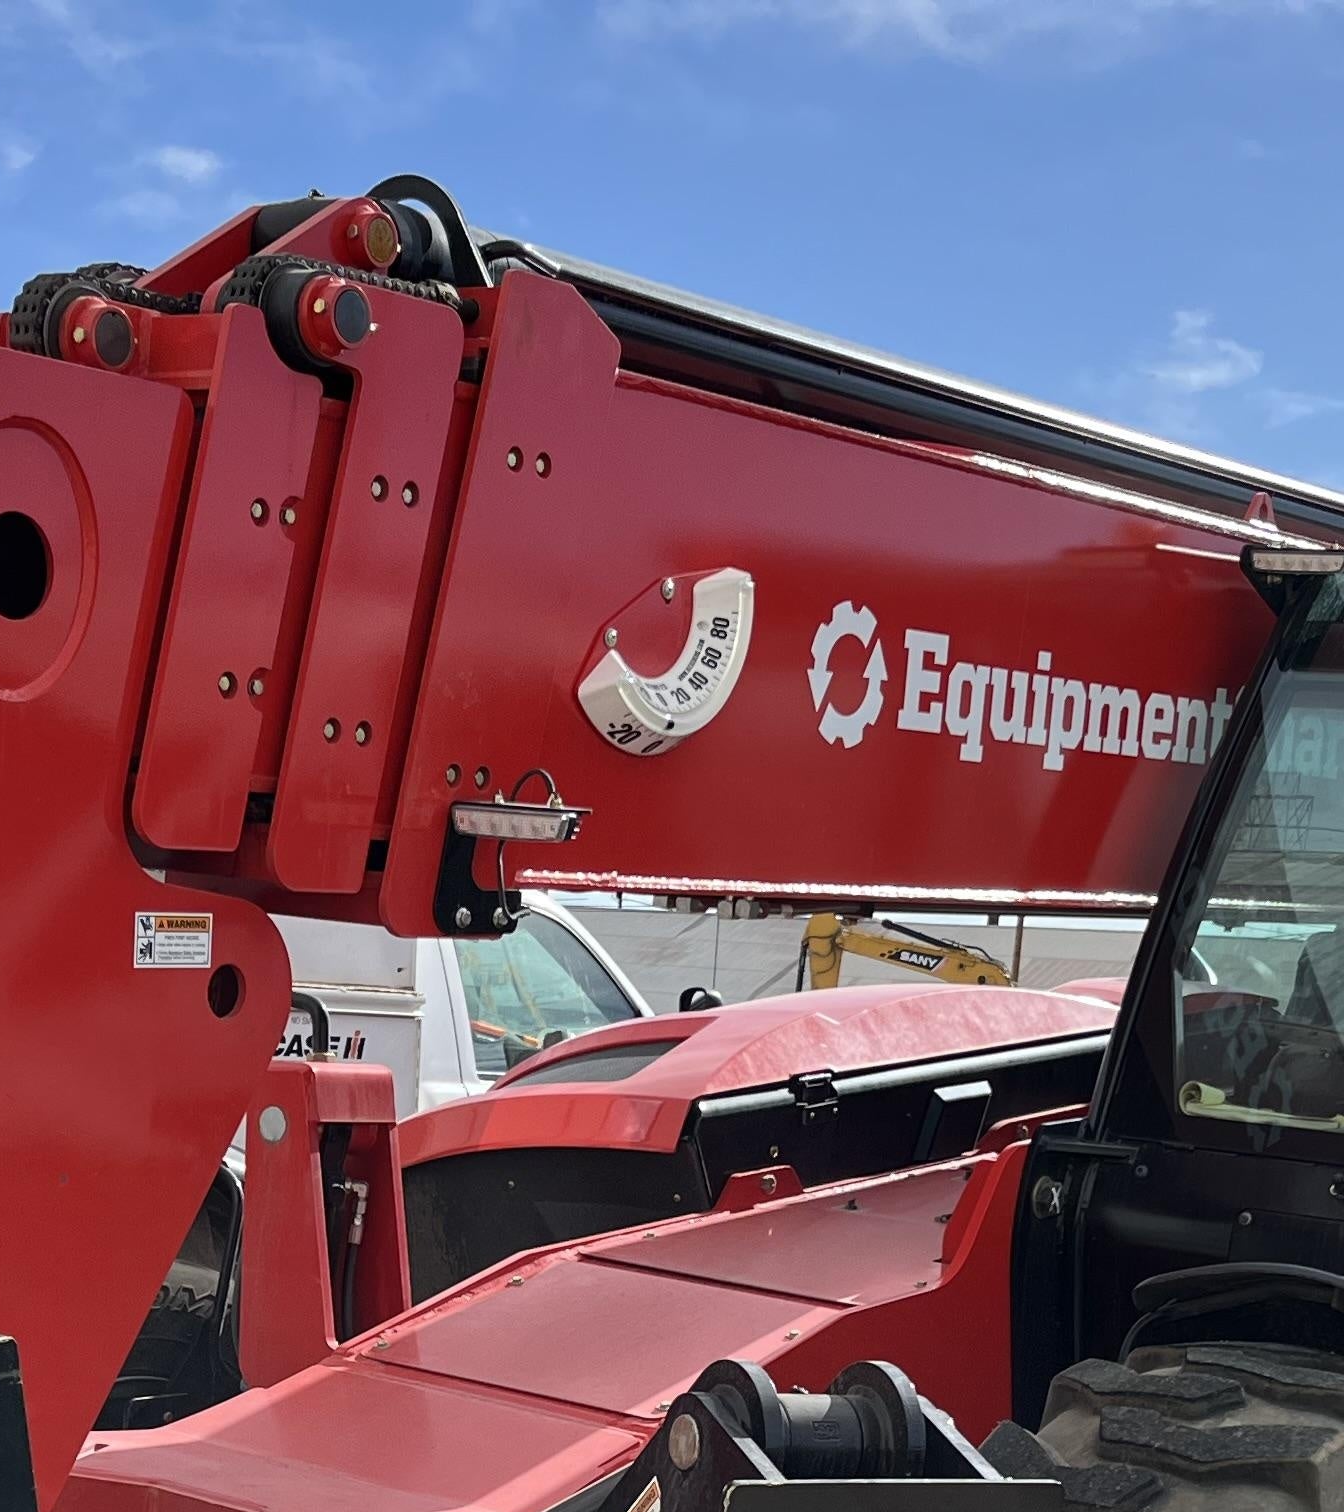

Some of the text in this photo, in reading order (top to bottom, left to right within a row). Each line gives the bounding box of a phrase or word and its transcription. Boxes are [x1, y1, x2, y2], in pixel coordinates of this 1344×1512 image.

[710, 616, 730, 640] 80
[701, 646, 722, 670] 60
[687, 671, 709, 691] 40
[671, 687, 691, 705] 20
[606, 721, 642, 745] -20
[167, 918, 207, 930] WARNING
[899, 951, 938, 968] SANY
